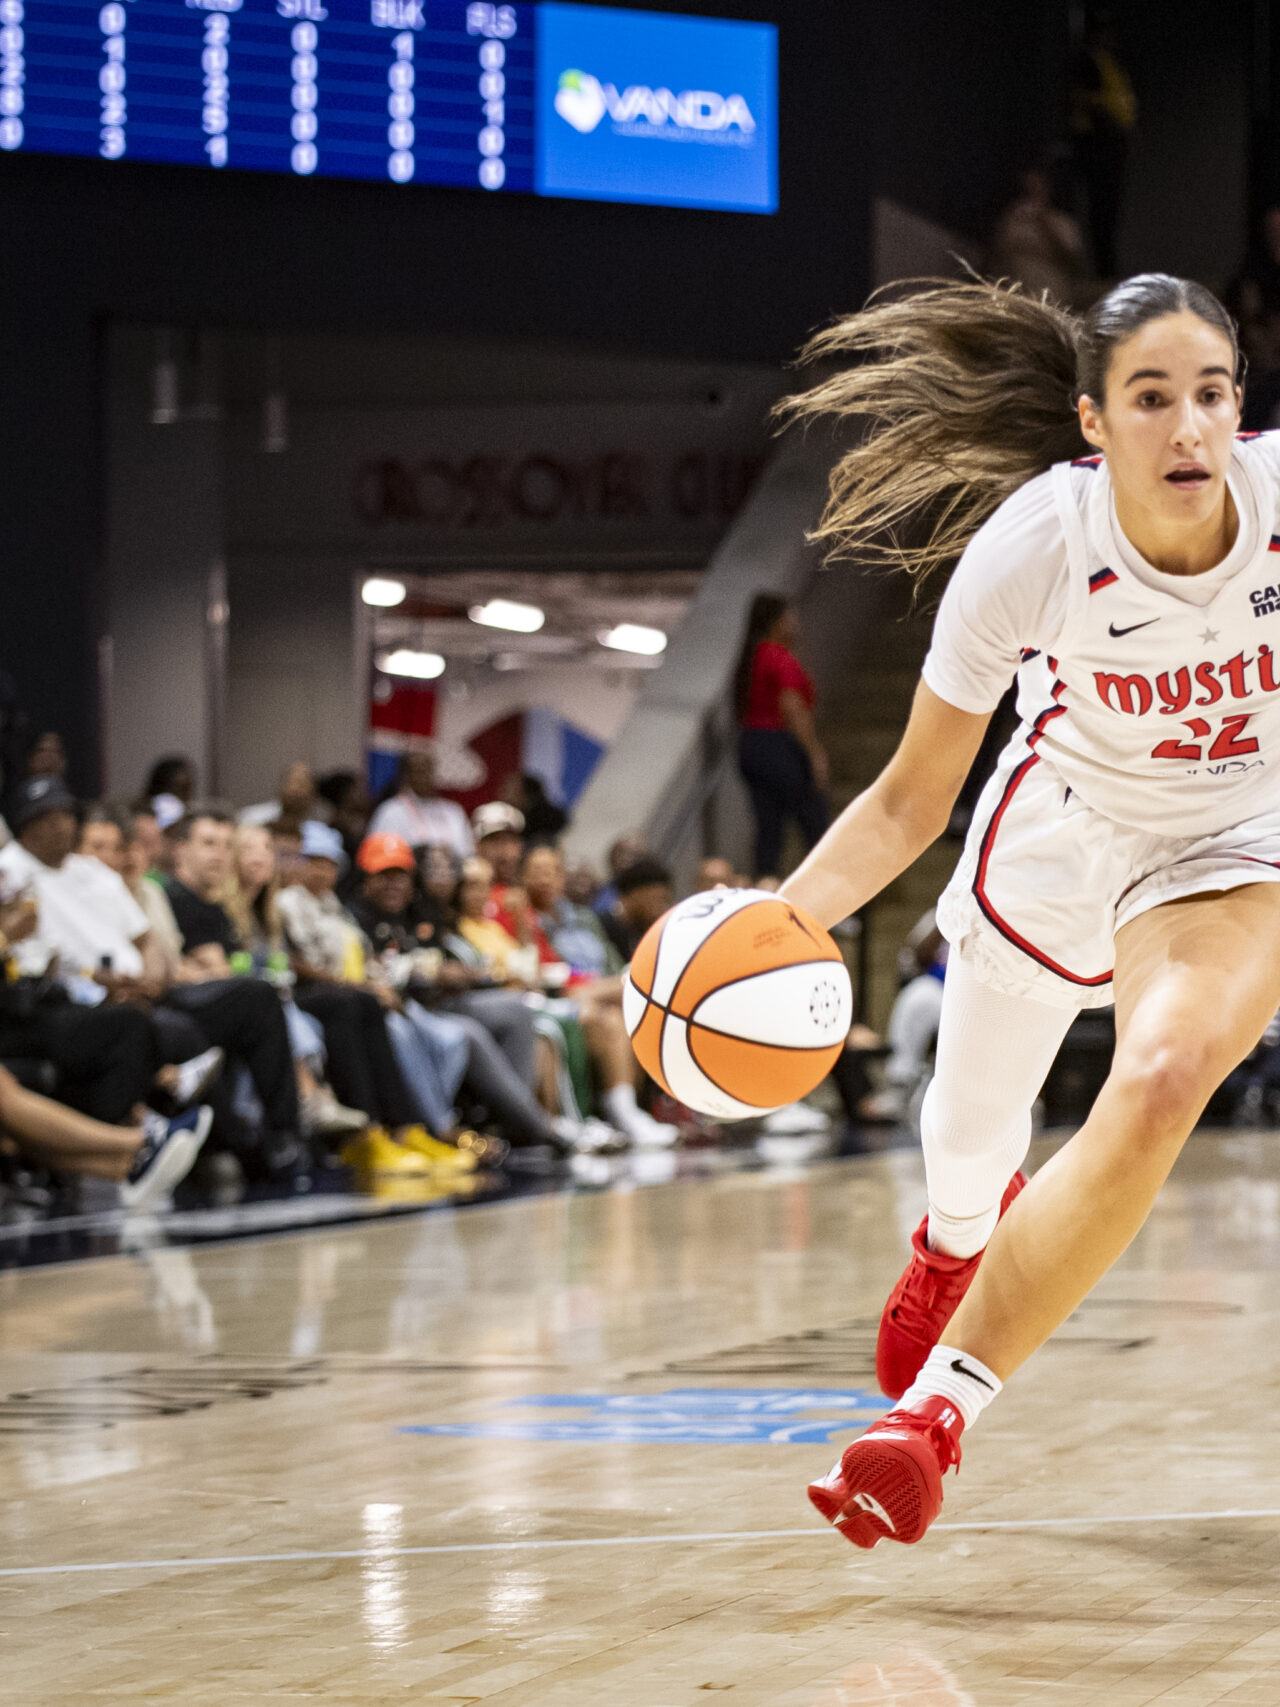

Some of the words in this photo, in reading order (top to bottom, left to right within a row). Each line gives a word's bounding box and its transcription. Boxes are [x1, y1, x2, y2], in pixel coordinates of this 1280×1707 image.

[99, 2, 126, 35] 0
[291, 21, 318, 53] 0
[391, 31, 415, 61] 1
[478, 39, 505, 72] 0
[99, 62, 126, 94] 0
[291, 80, 318, 112] 0
[388, 90, 415, 121] 0
[482, 99, 505, 127] 1
[102, 34, 126, 63] 1
[202, 44, 229, 74] 0
[291, 51, 318, 83] 0
[388, 60, 415, 92] 0
[478, 70, 505, 101] 0
[291, 110, 318, 142] 0
[388, 119, 415, 151] 0
[478, 125, 505, 157] 0
[601, 82, 756, 134] VANDA
[205, 134, 229, 167] 1
[291, 141, 318, 175] 0
[388, 149, 415, 183] 0
[478, 156, 505, 190] 0
[1151, 711, 1260, 761] 22
